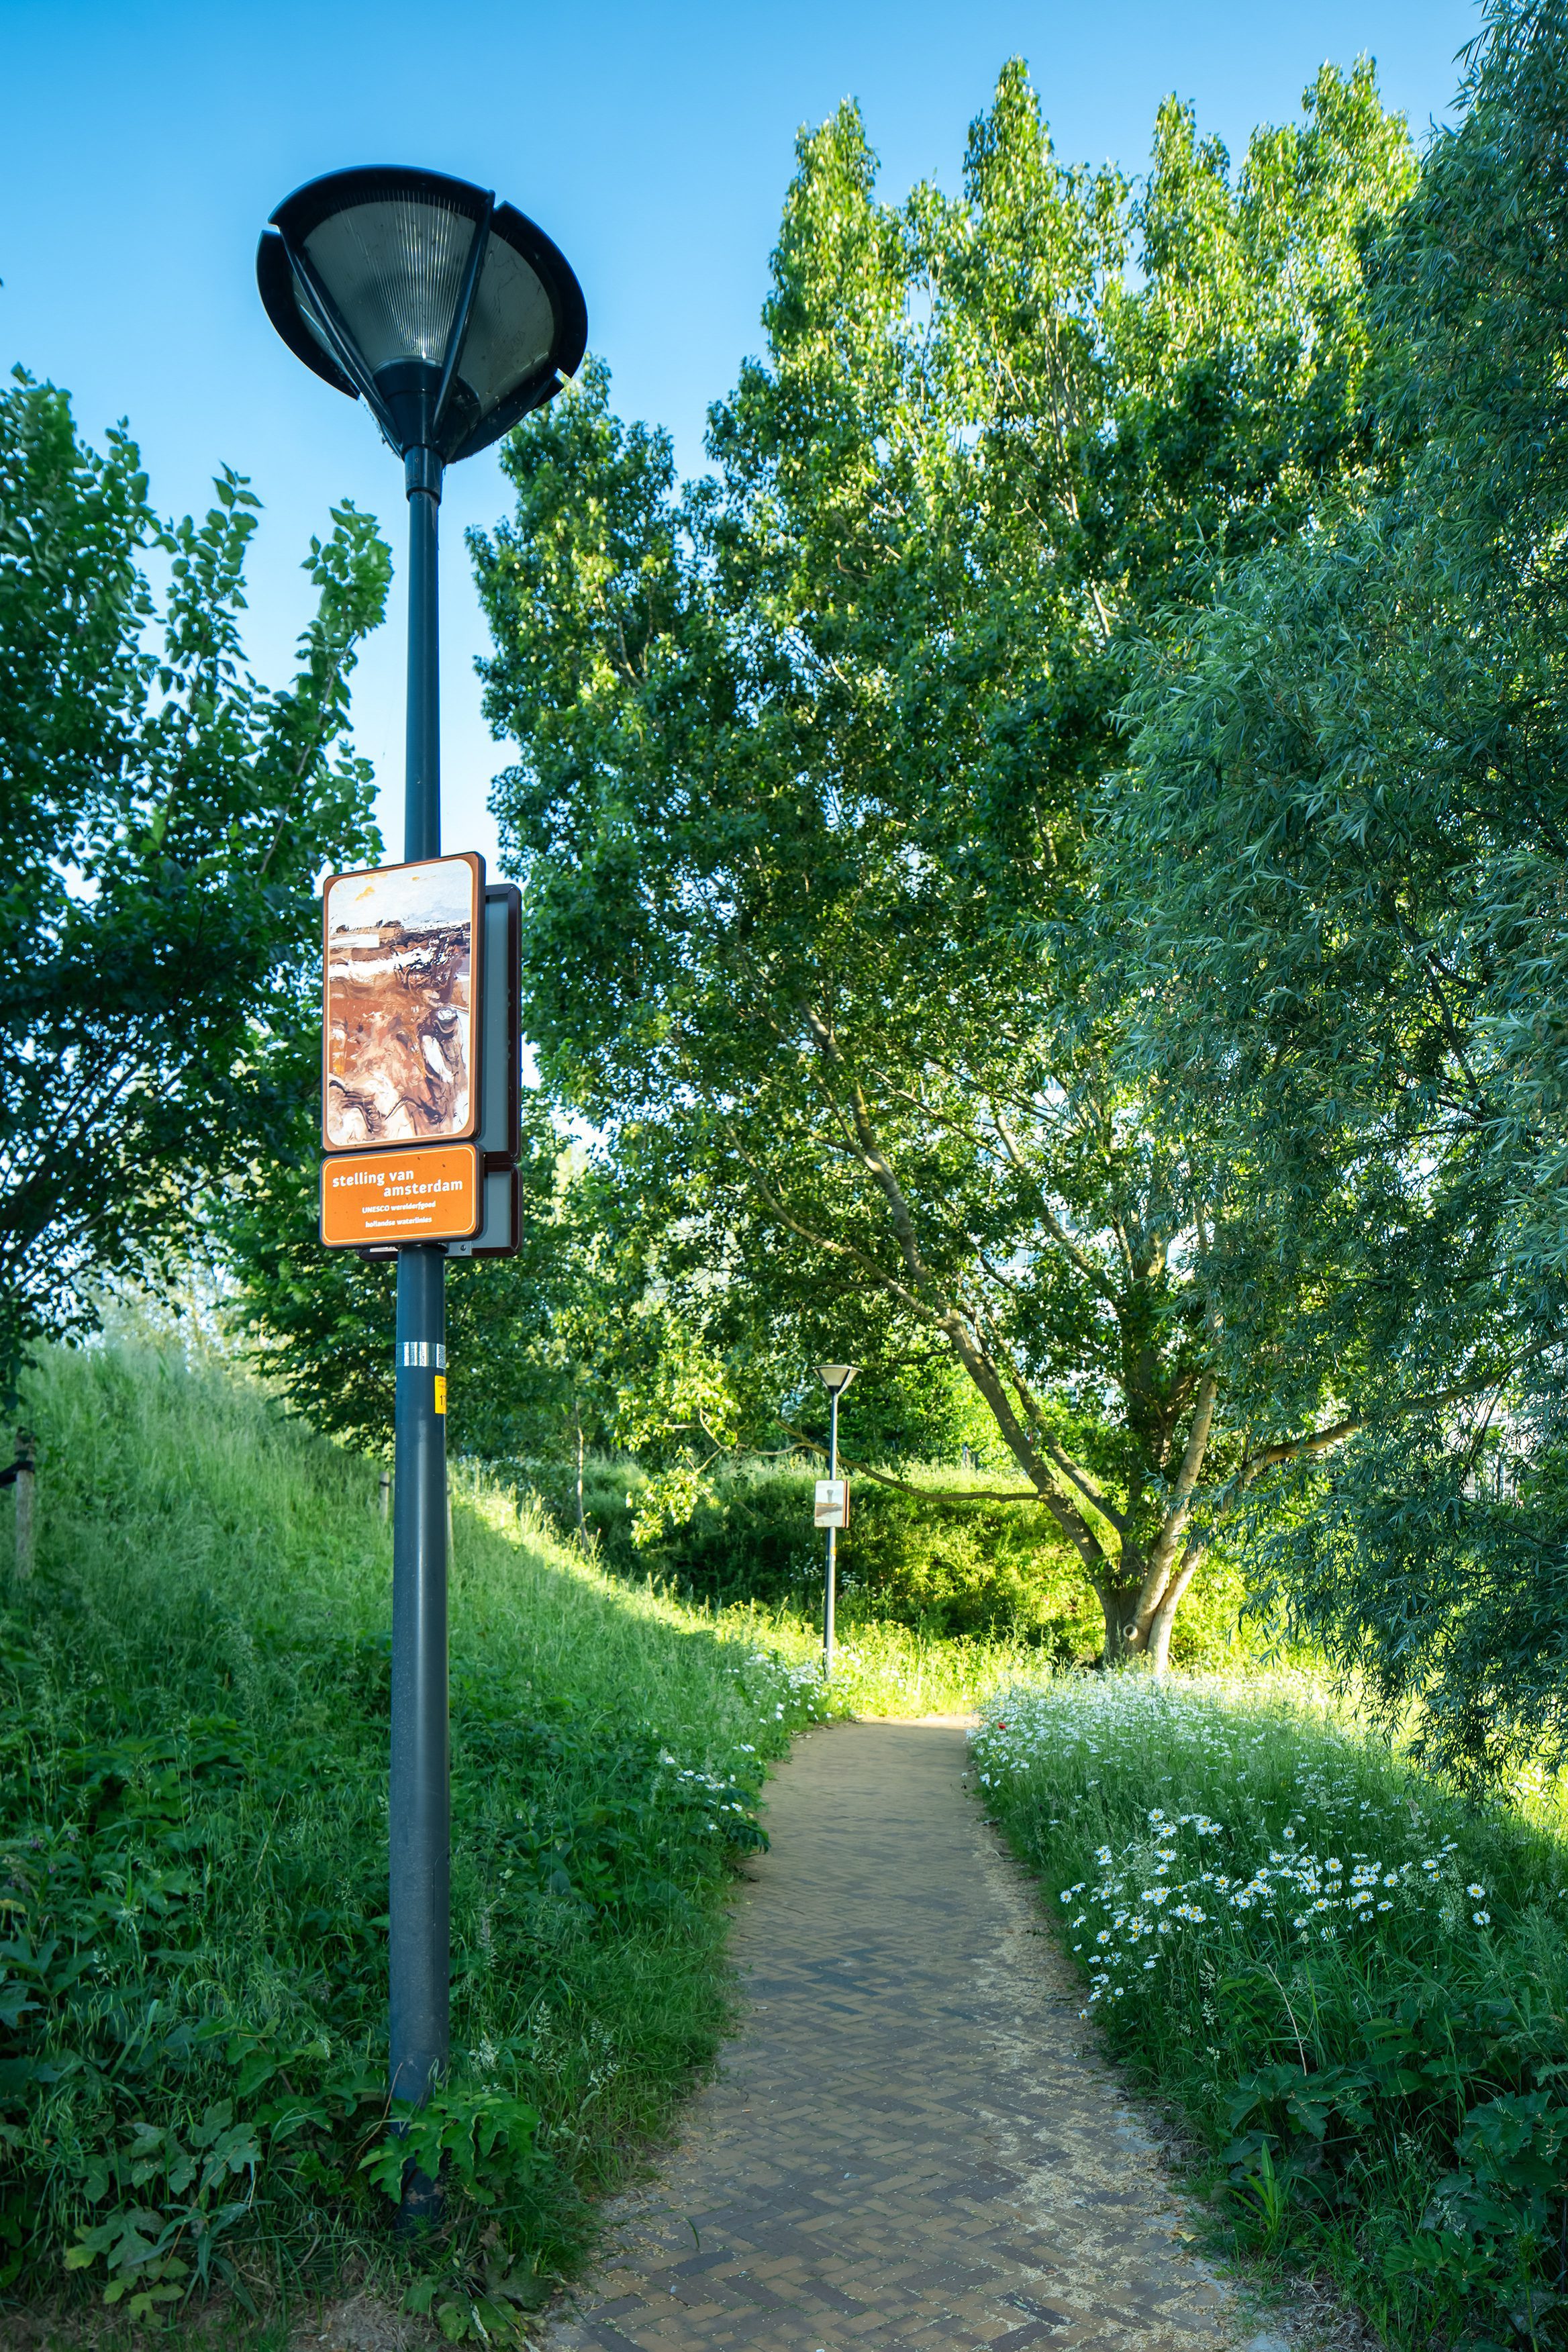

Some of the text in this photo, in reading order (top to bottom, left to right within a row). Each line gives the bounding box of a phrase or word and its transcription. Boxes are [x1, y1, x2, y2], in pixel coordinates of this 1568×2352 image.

[332, 1170, 414, 1187] stelling van
[384, 1179, 463, 1197] amsterdam
[362, 1201, 436, 1214] UNESCO werelderfgoed
[365, 1216, 432, 1228] hollandse waterlinies
